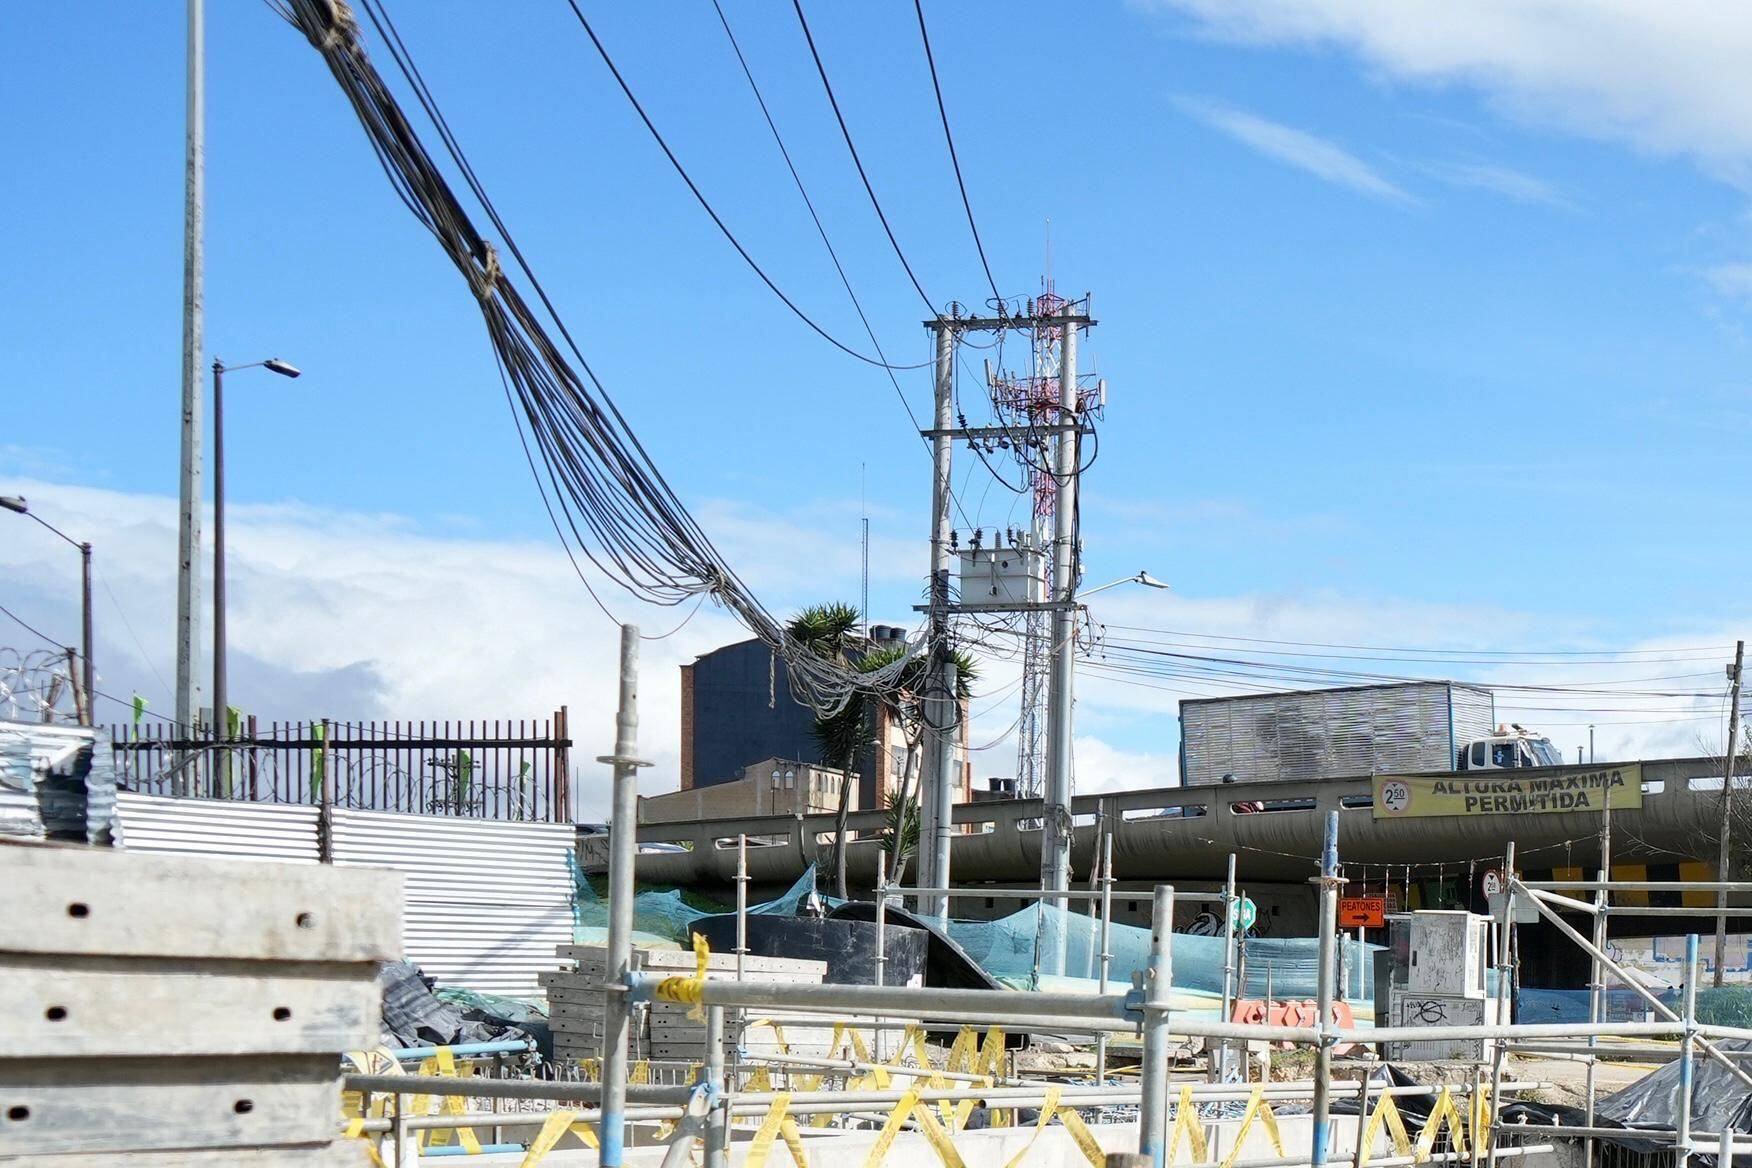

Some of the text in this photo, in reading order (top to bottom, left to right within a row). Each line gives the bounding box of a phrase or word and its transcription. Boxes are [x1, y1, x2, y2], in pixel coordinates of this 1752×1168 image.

[1433, 781, 1522, 795] ALTURA
[1465, 791, 1590, 812] PERMITIDA
[1341, 901, 1381, 911] PEATONES
